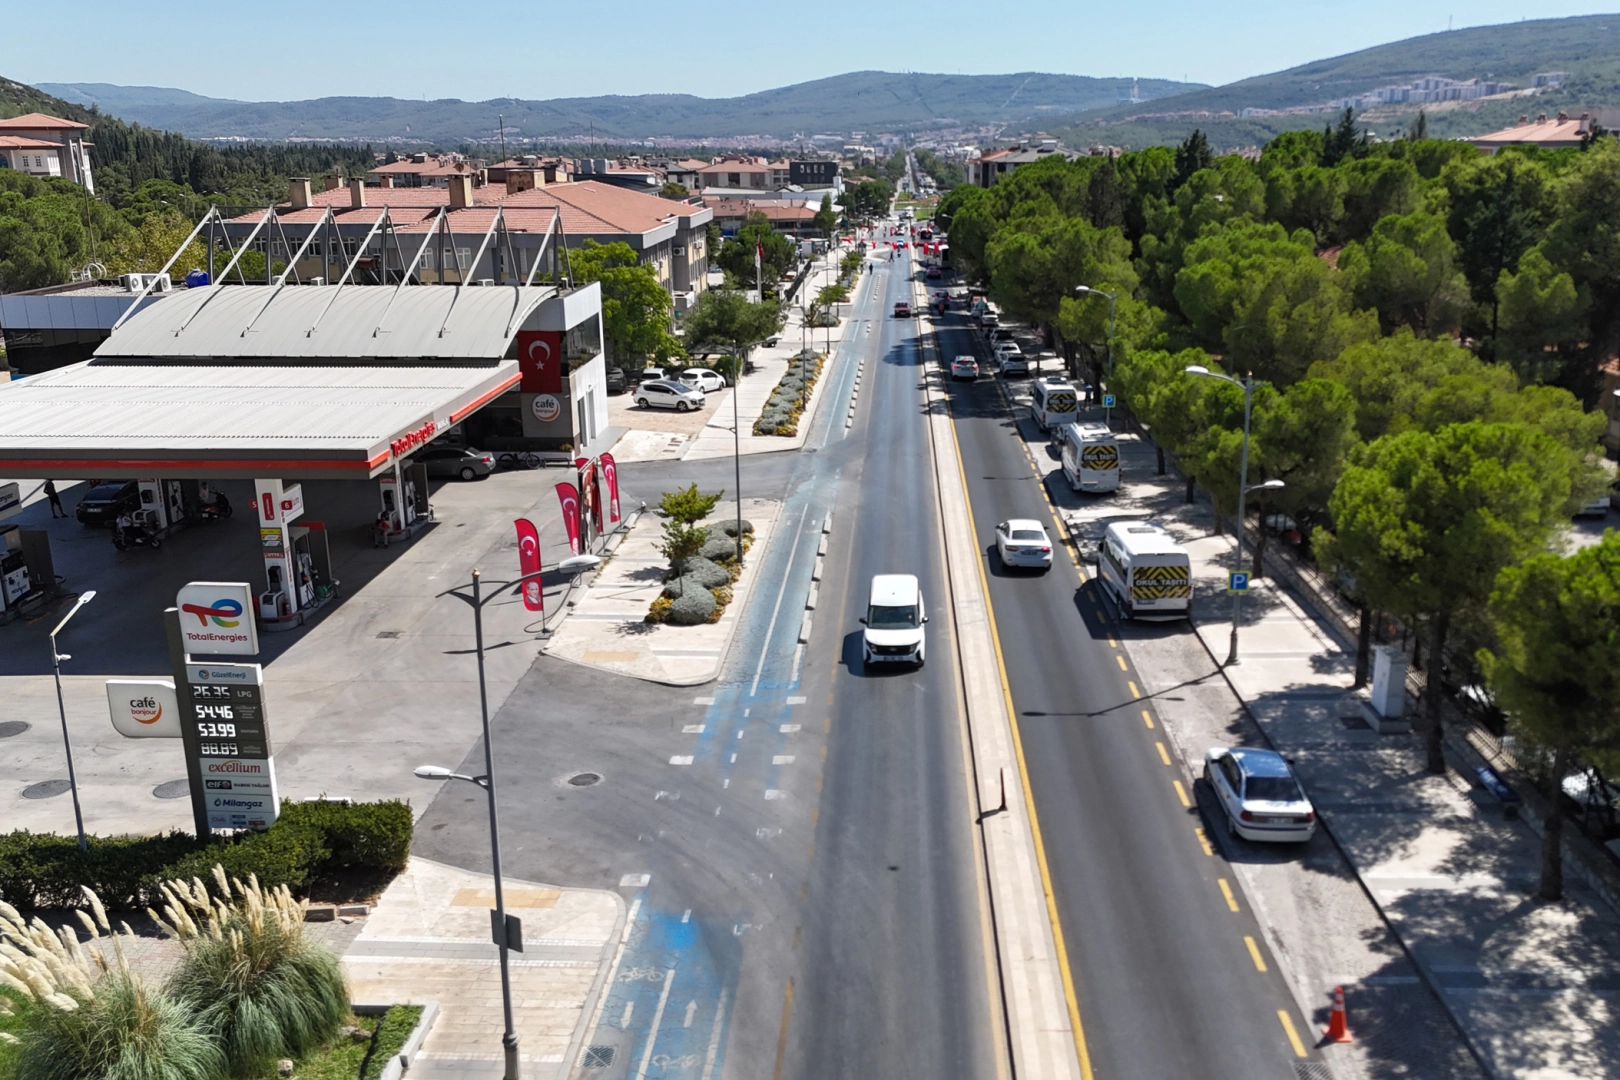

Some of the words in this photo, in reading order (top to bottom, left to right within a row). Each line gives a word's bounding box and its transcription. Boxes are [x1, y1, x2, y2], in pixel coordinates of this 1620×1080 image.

[535, 399, 555, 408] café
[1160, 579, 1187, 587] TAŞITI
[1232, 574, 1245, 589] P
[186, 632, 248, 643] TotalEnergies
[211, 671, 247, 680] GüzelEnerji
[237, 690, 252, 698] LPG
[129, 696, 156, 708] café
[130, 708, 157, 716] bonjour
[195, 704, 234, 719] 54.46
[198, 723, 237, 737] 53.99
[208, 762, 261, 773] excellium
[222, 799, 263, 810] Milangaz
